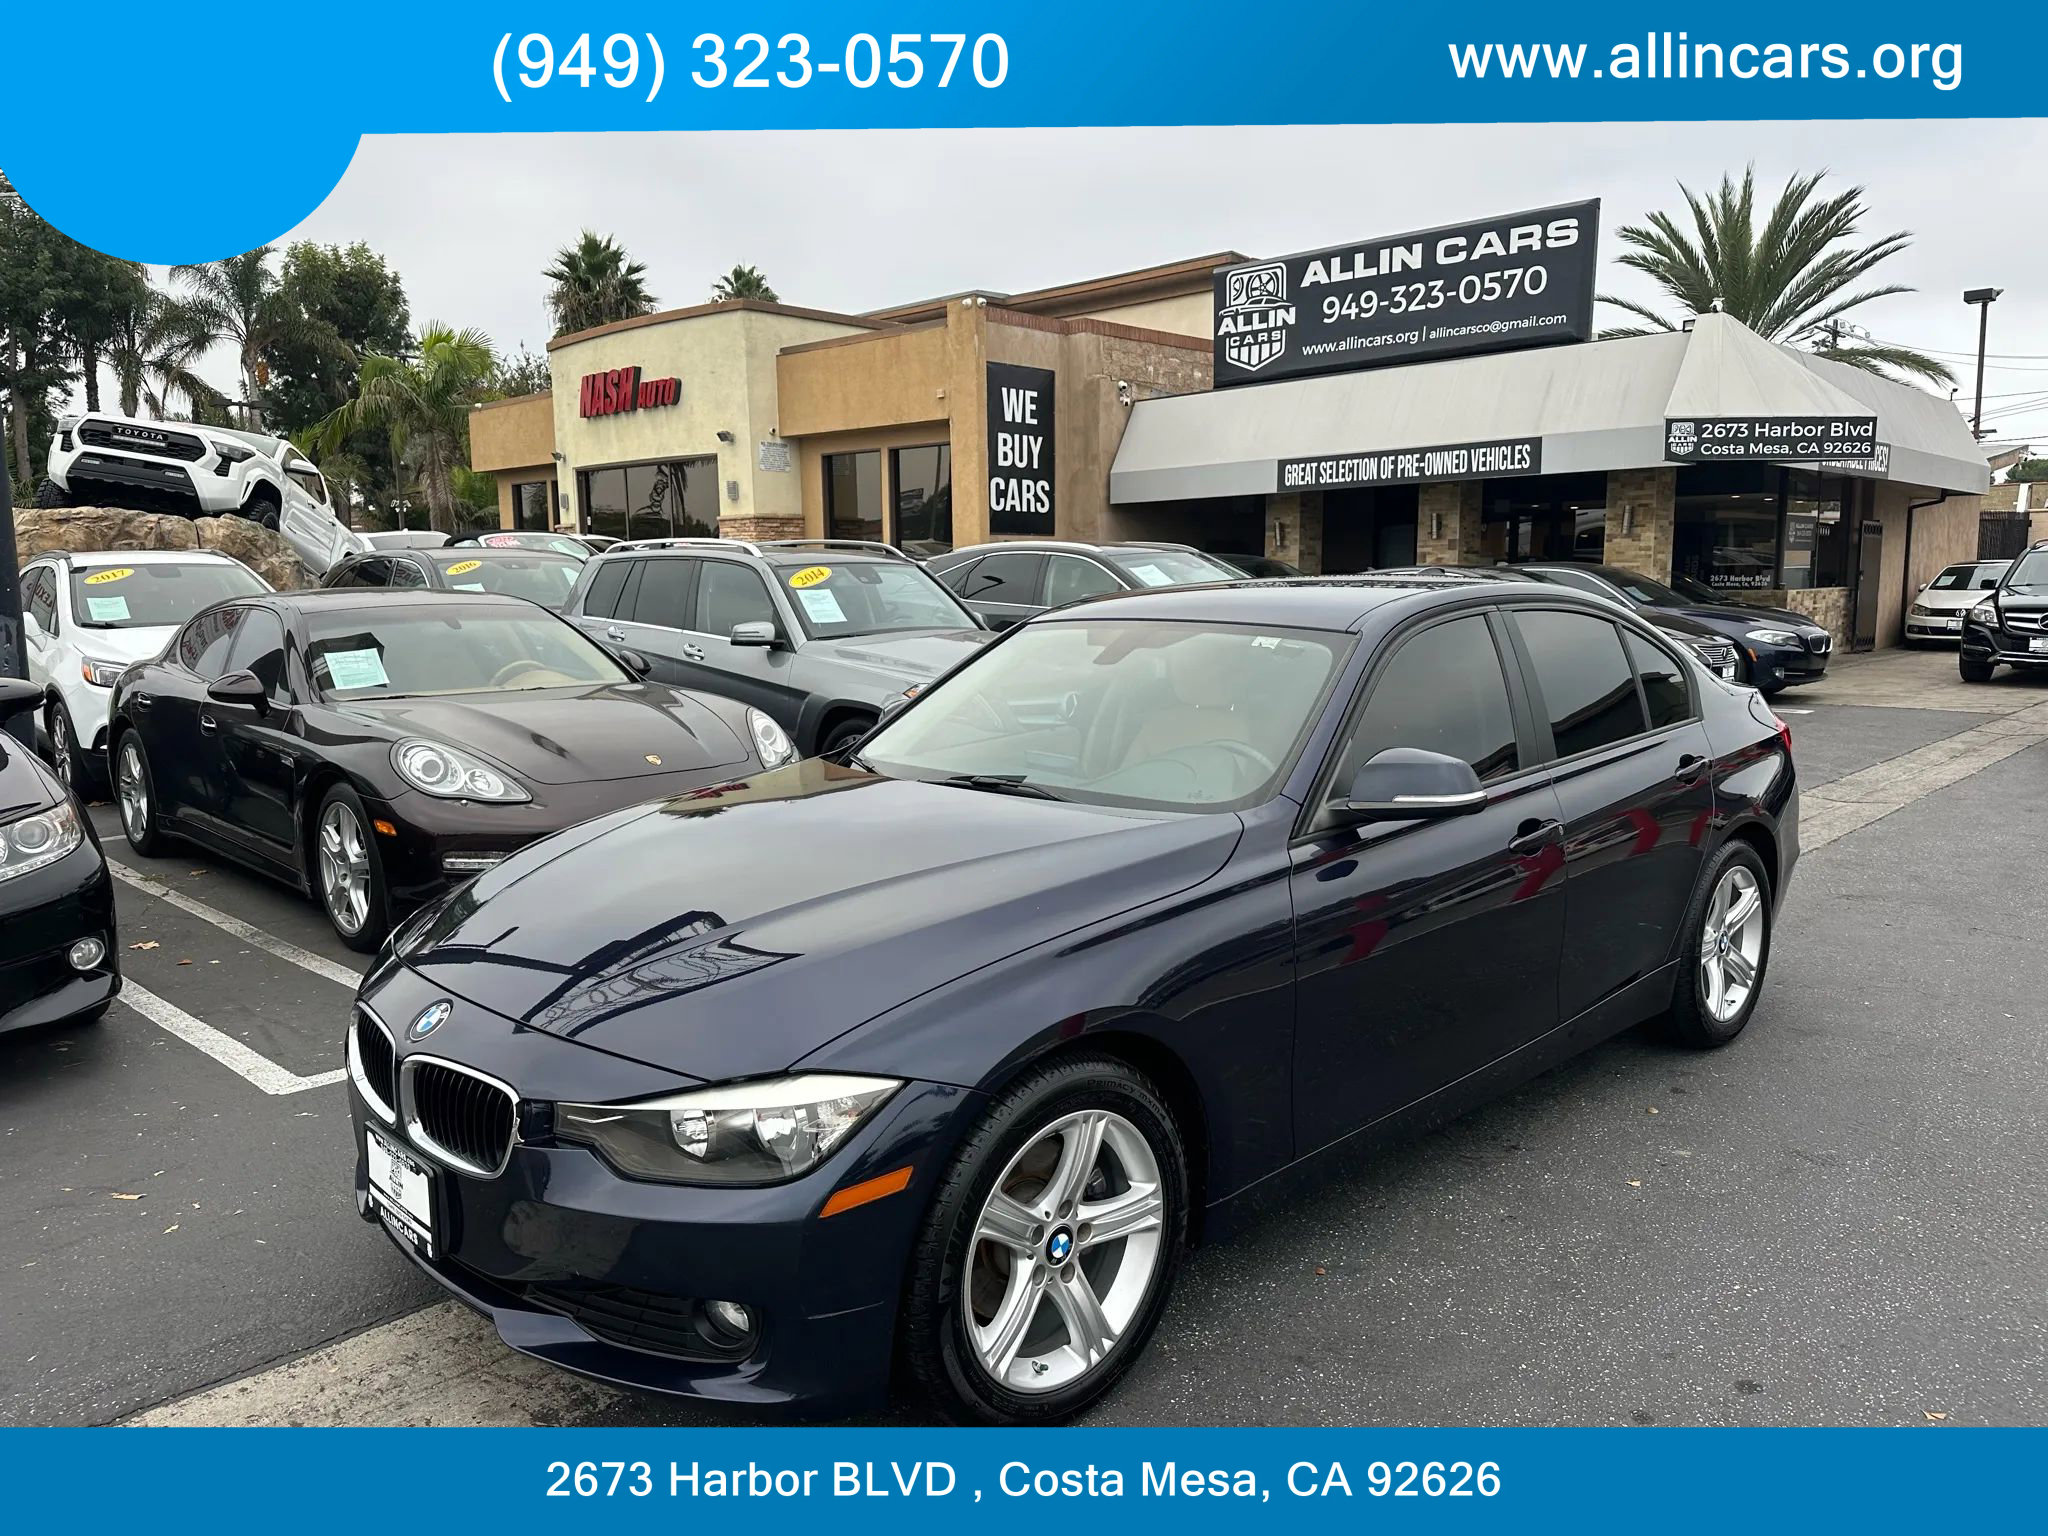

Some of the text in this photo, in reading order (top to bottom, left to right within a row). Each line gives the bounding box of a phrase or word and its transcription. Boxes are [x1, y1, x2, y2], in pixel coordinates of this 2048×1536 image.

[1300, 218, 1579, 288] ALLIN CARS
[1321, 265, 1548, 324] 949-323-0570
[1217, 306, 1296, 347] ALLIN CARS
[1302, 329, 1419, 356] www.allincars.org
[1429, 313, 1568, 340] allincarsco@gmail.com
[580, 366, 682, 418] NASH AUTO
[1001, 387, 1038, 424] WE
[116, 427, 164, 441] TOYOTA
[1700, 421, 1874, 438] 2673 Harbor Blvd
[997, 432, 1043, 469] BUY
[1284, 444, 1531, 488] GREAT SELECTION OF PRE-OWNED VEHICLES
[1700, 442, 1872, 455] Costa Mesa, CA 92626
[990, 477, 1050, 513] CARS
[93, 570, 125, 583] 2017
[452, 562, 477, 574] 2016
[797, 568, 826, 586] 2014
[1710, 574, 1772, 582] 2673 Harbor Blvd
[379, 1206, 419, 1246] ALLINCARS
